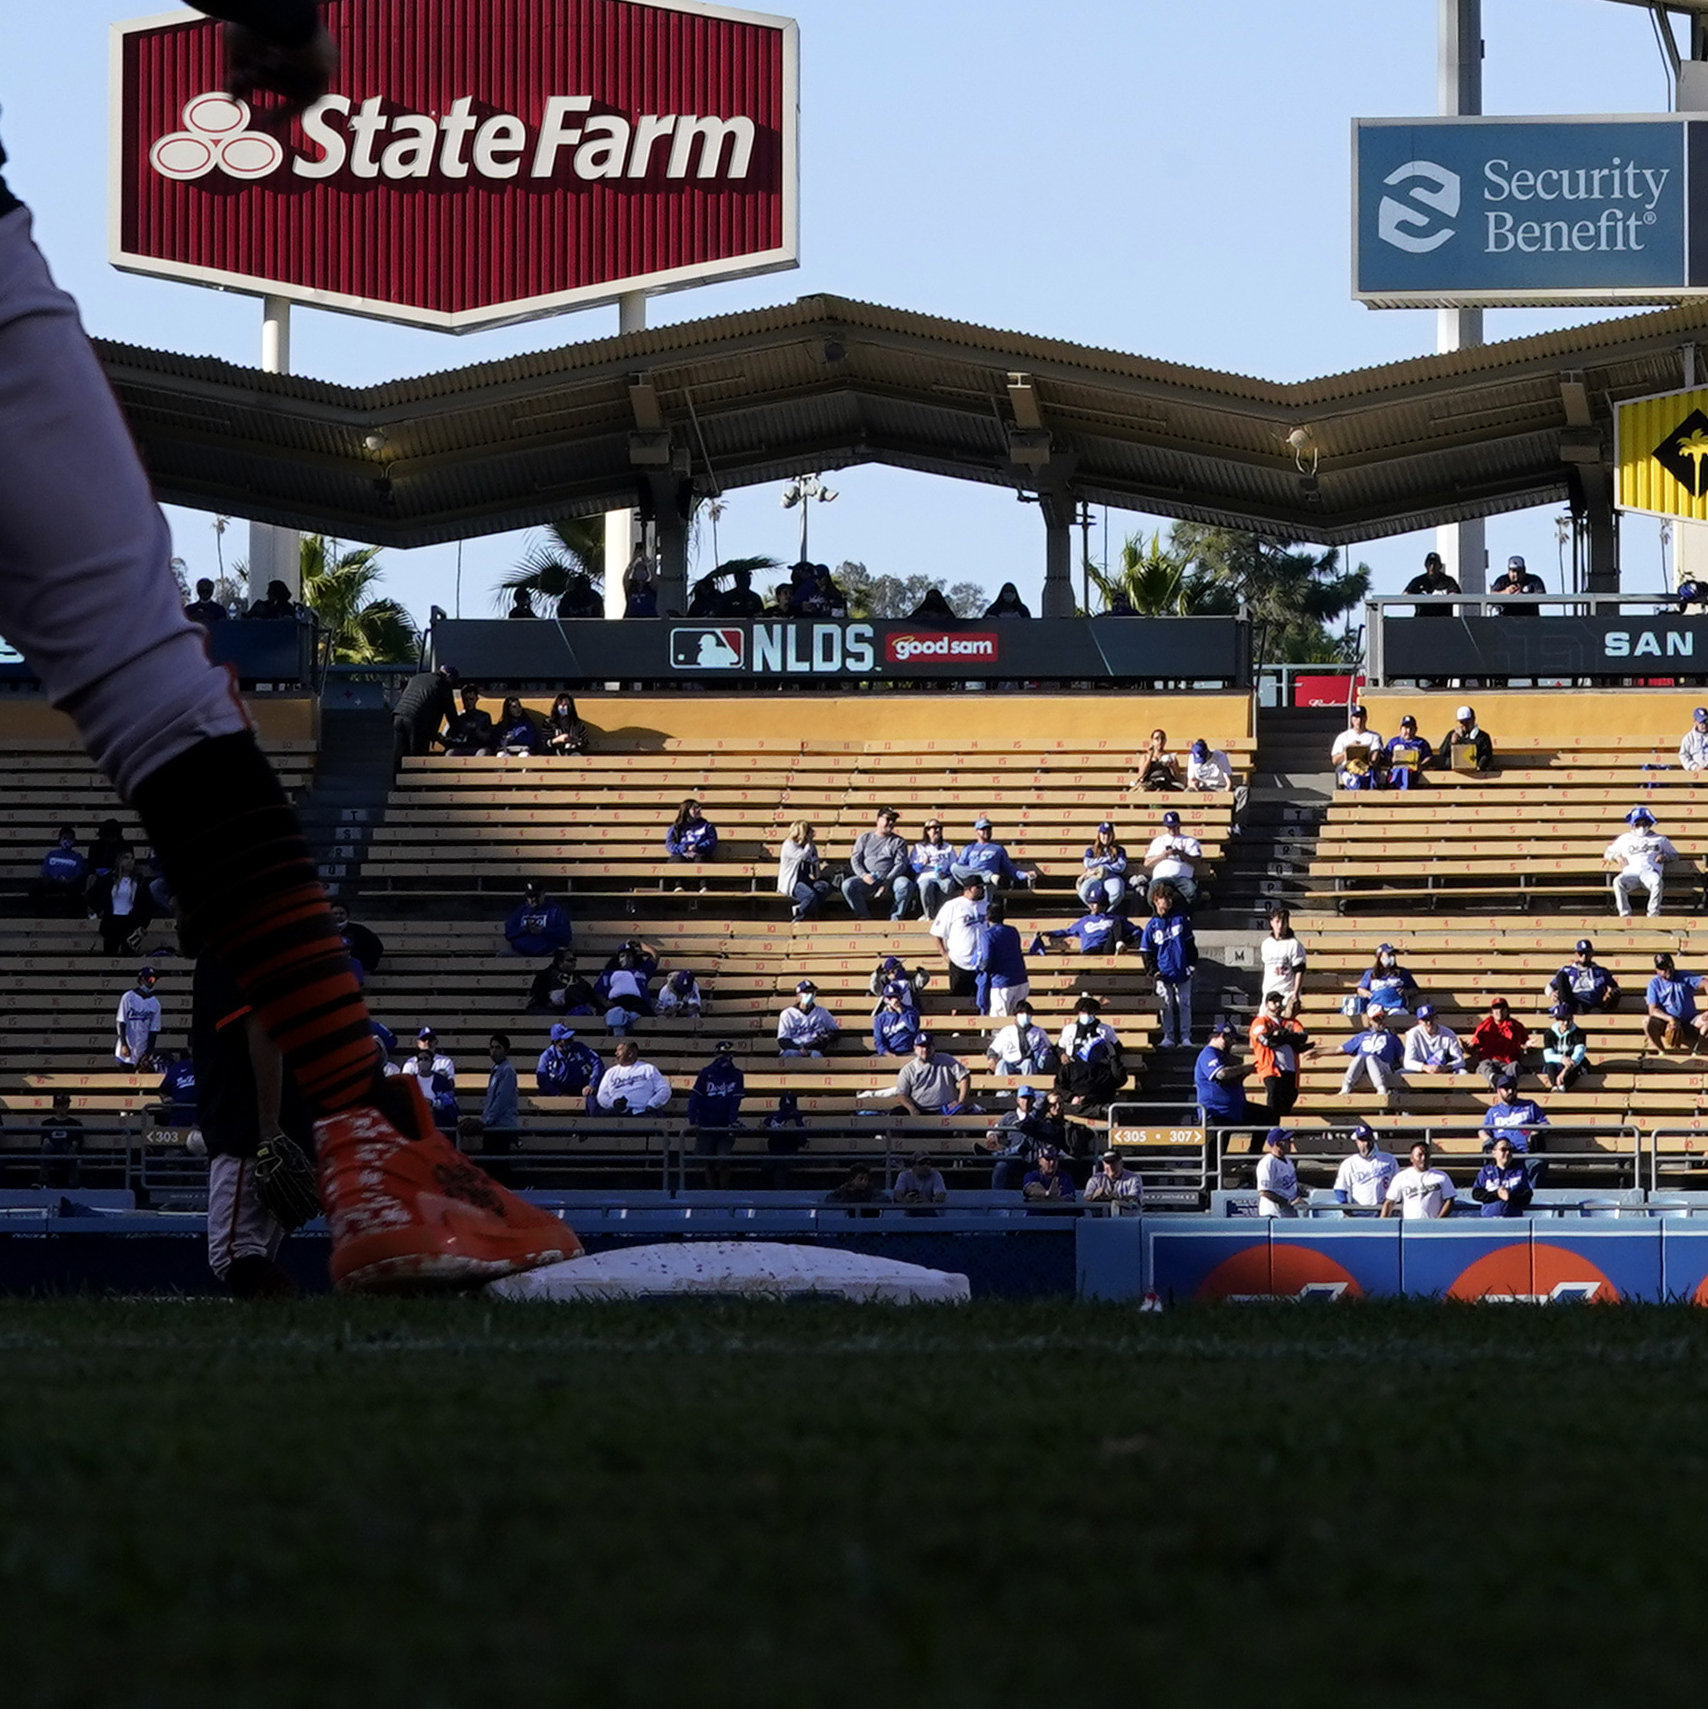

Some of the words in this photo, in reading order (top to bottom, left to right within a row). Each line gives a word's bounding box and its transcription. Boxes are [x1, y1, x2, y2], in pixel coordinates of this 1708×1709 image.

[292, 94, 526, 179] State
[531, 95, 755, 180] Farm
[1484, 156, 1670, 210] Security
[895, 636, 949, 660] good
[950, 640, 992, 654] sam
[1604, 631, 1693, 657] SAN
[155, 1130, 180, 1143] 303
[1123, 1130, 1147, 1143] 305
[1169, 1130, 1193, 1143] 307
